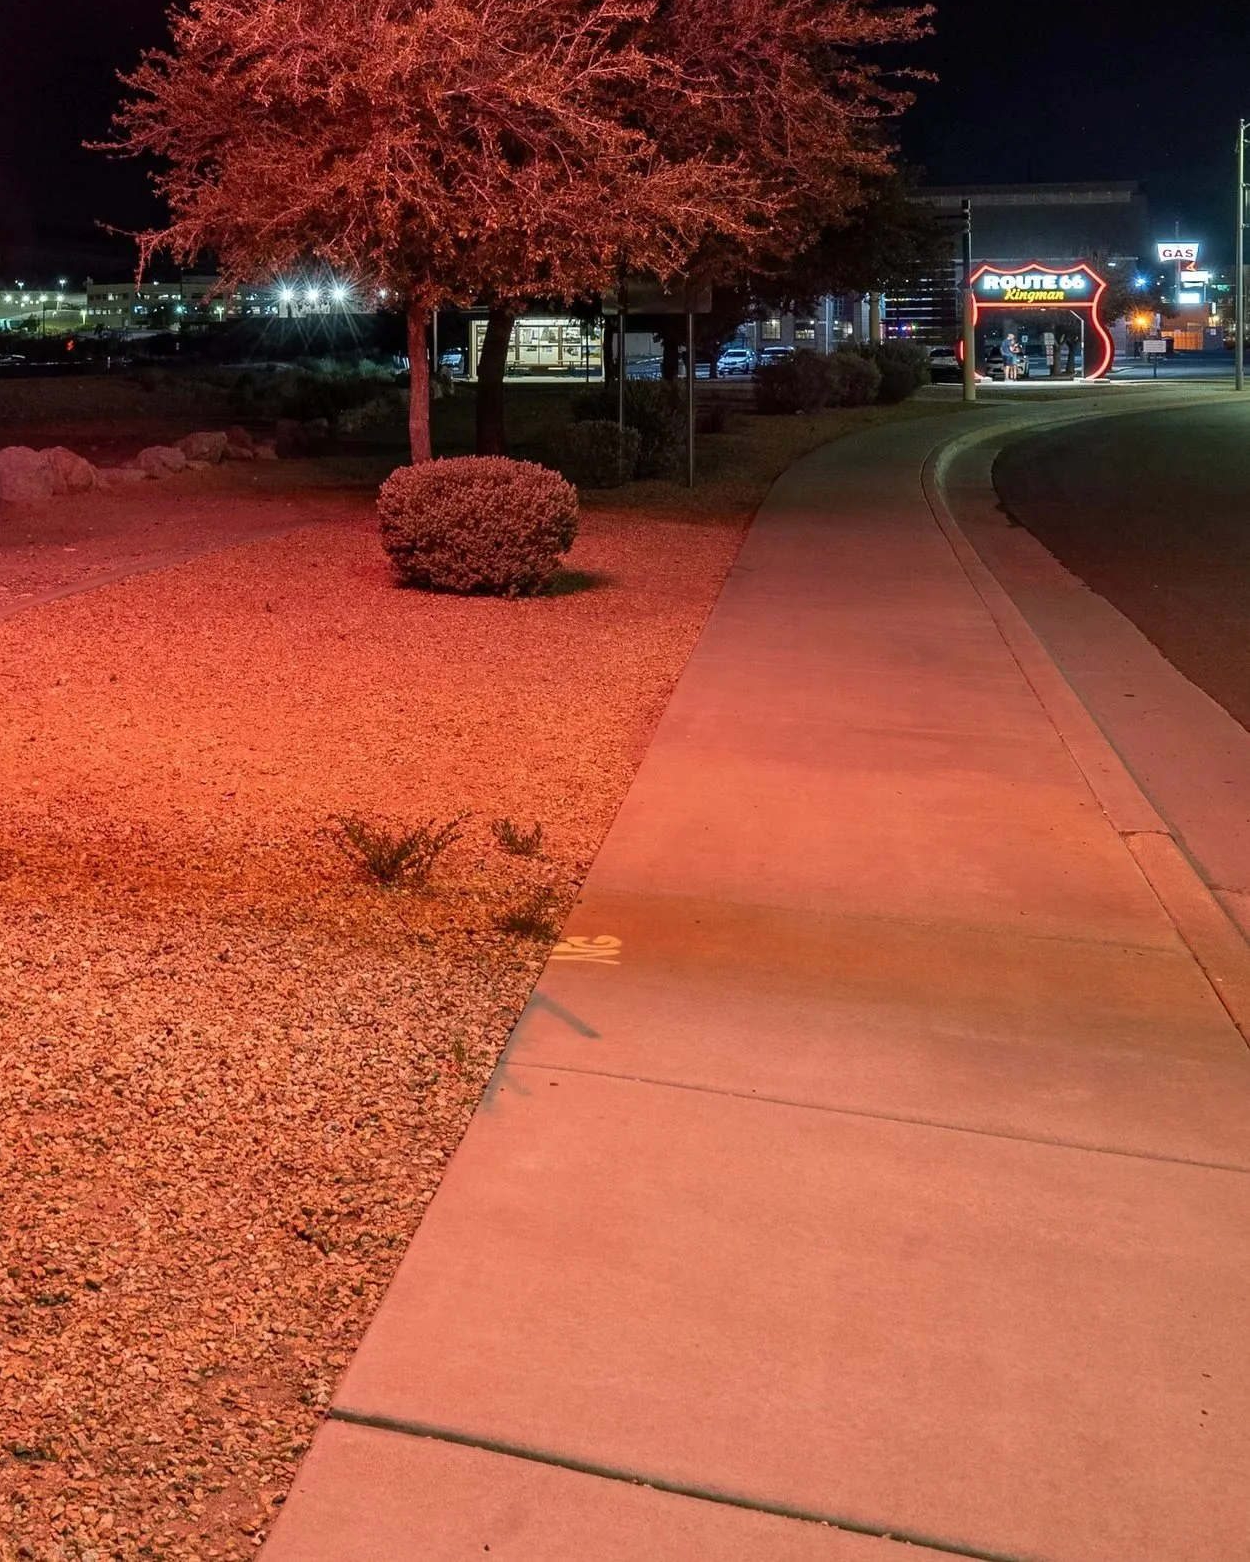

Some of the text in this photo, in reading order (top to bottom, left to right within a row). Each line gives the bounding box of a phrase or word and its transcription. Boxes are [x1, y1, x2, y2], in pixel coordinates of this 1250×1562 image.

[1162, 249, 1194, 258] GAS
[983, 274, 1086, 290] ROUTE 66
[1004, 288, 1065, 304] Kingman
